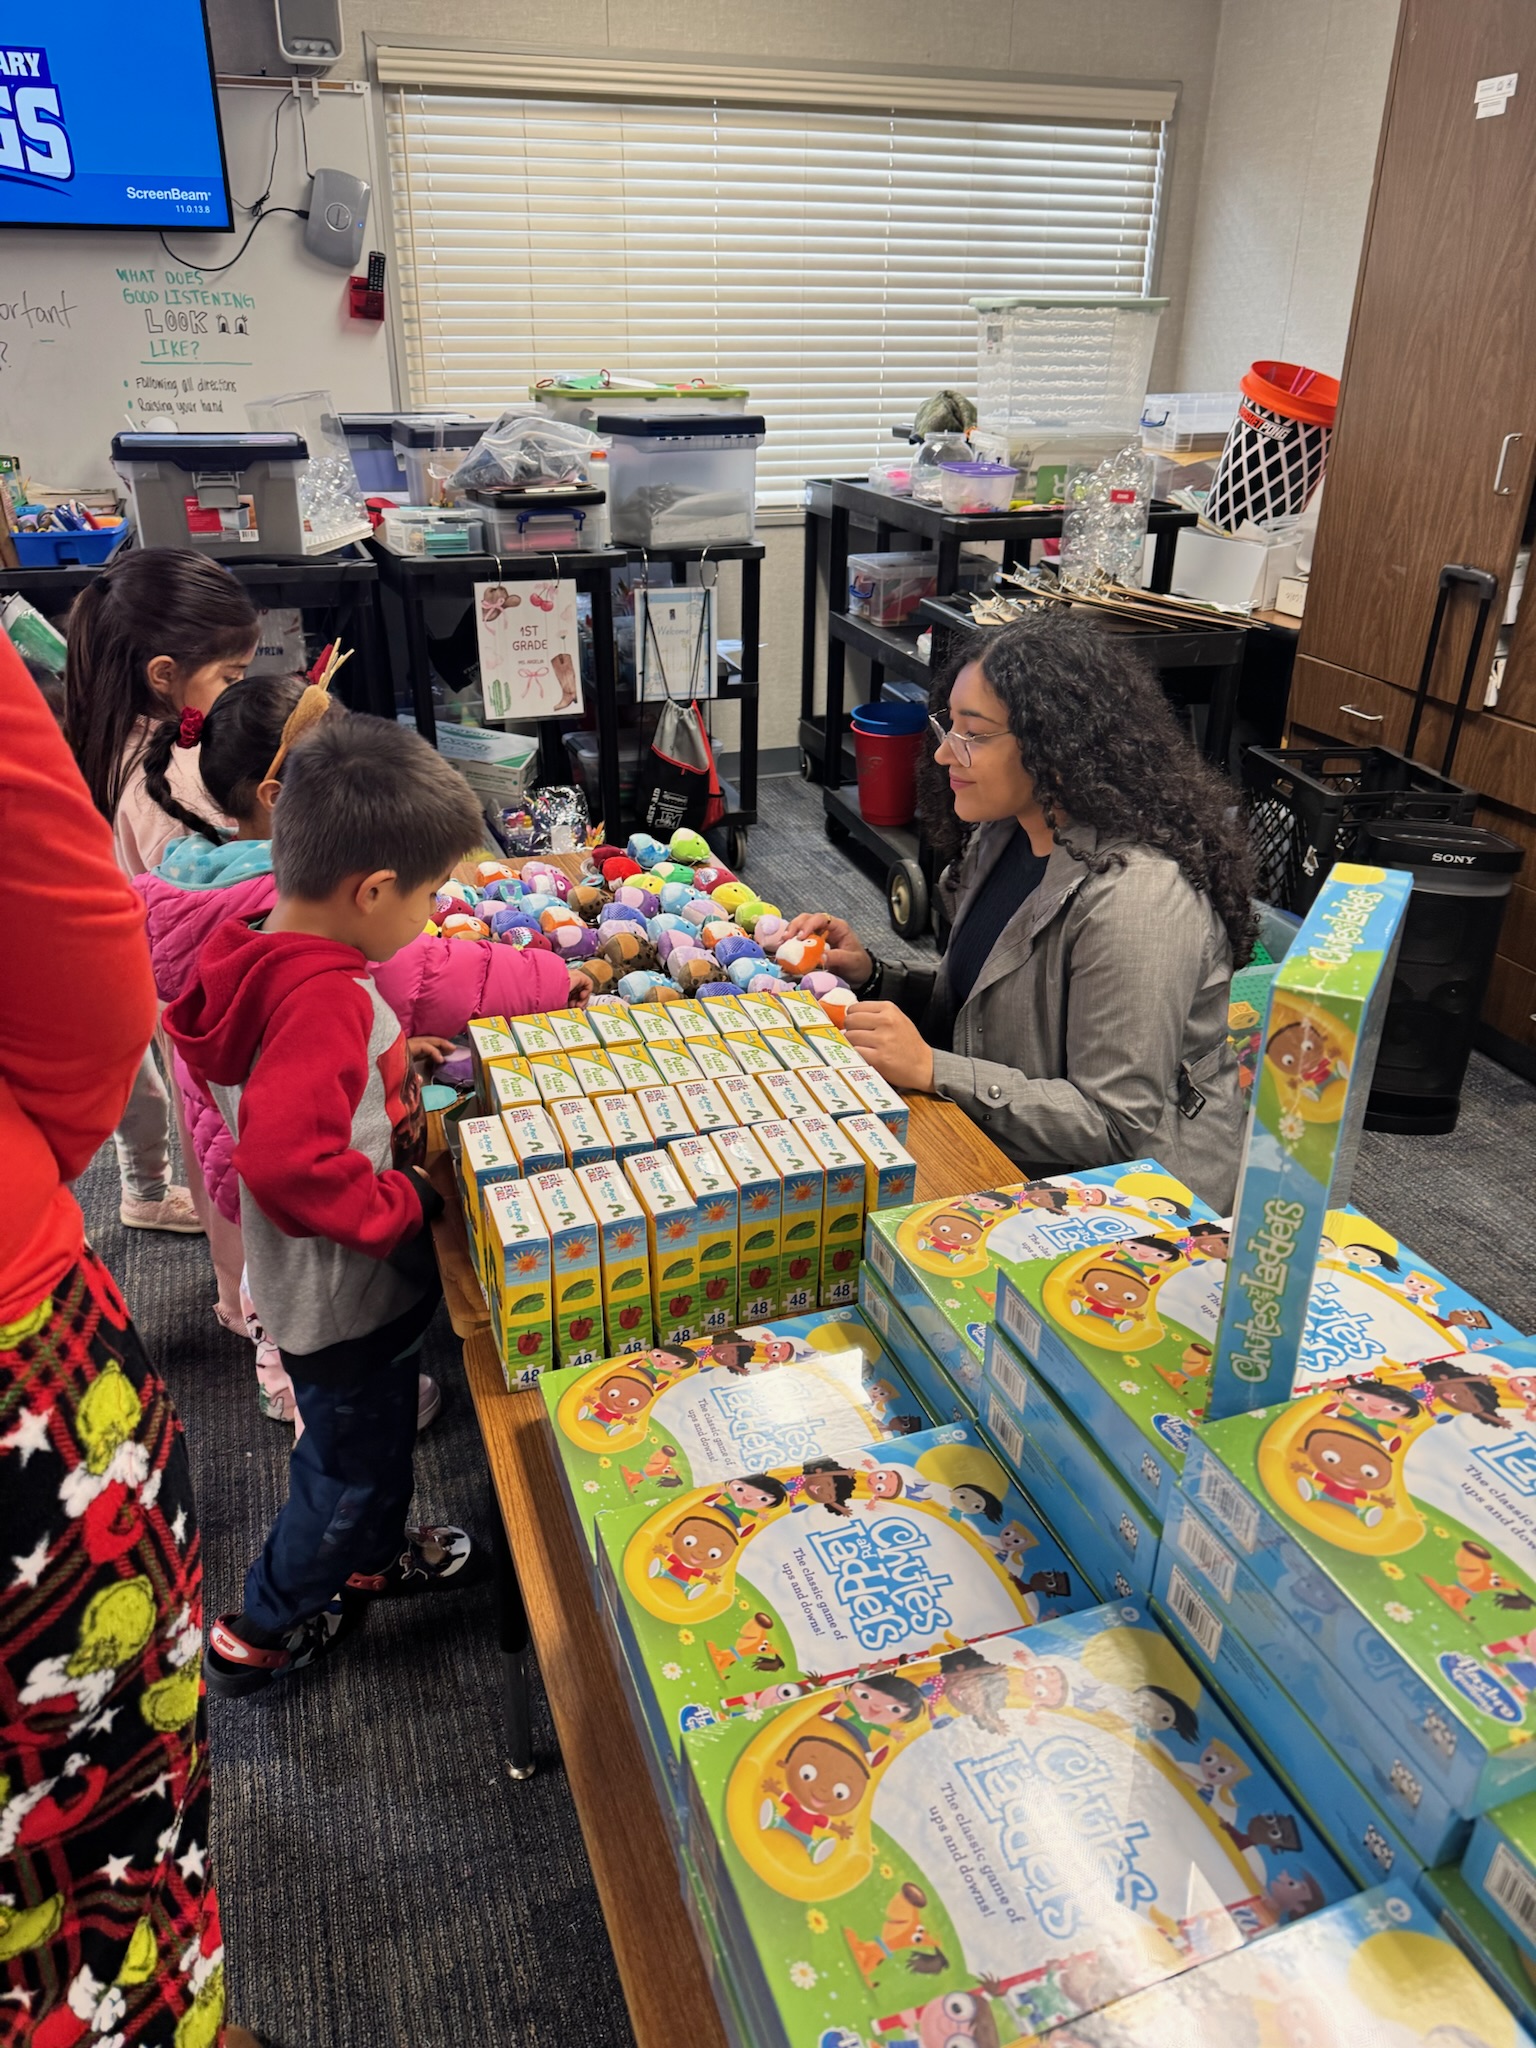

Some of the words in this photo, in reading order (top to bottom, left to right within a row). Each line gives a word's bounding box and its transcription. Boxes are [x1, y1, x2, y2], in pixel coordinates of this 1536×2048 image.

[127, 187, 208, 201] ScreenBeam
[176, 205, 210, 214] 11.0.13.8
[116, 269, 155, 283] WHAT
[165, 271, 204, 285] DOES
[123, 288, 159, 304] GOOD
[164, 290, 255, 309] LISTENING
[145, 309, 208, 334] LOOK
[150, 339, 200, 360] LIKE?
[136, 377, 179, 398] Following
[181, 377, 194, 393] all
[137, 398, 175, 415] Raising
[176, 403, 198, 415] your
[200, 399, 224, 413] hand
[520, 625, 539, 637] 1ST
[512, 640, 548, 651] GRADE
[1432, 853, 1477, 865] SONY
[686, 1014, 704, 1032] Puzzle
[725, 1010, 742, 1027] Puzzle
[760, 1007, 778, 1024] Puzzle
[799, 1006, 817, 1022] Puzzle
[568, 1025, 584, 1042] Puzzle
[610, 1020, 627, 1037] Puzzle
[651, 1018, 668, 1036] Puzzle
[488, 1034, 504, 1052] Puzzle
[531, 1031, 548, 1048] Puzzle
[709, 1052, 728, 1072] Puzzle
[750, 1049, 767, 1068] Puzzle
[789, 1045, 809, 1063] Puzzle
[831, 1045, 851, 1064] Puzzle
[630, 1063, 648, 1082] Puzzle
[670, 1056, 690, 1076] Puzzle
[551, 1072, 568, 1093] Puzzle
[591, 1068, 608, 1086] Puzzle
[509, 1077, 526, 1097] Puzzle
[1240, 1199, 1304, 1295] Ladders
[790, 1293, 807, 1306] 48
[833, 1284, 850, 1297] 48
[750, 1302, 768, 1315] 48
[708, 1312, 726, 1326] 48
[1230, 1300, 1281, 1382] Chutes
[688, 1409, 697, 1423] ups
[694, 1422, 705, 1438] and
[700, 1437, 718, 1463] downs!
[698, 1398, 708, 1413] The
[704, 1412, 719, 1438] classic
[716, 1438, 731, 1458] game
[724, 1457, 736, 1467] of
[1461, 1481, 1486, 1504] ups
[1484, 1503, 1514, 1527] and
[1464, 1464, 1489, 1487] The
[1488, 1487, 1534, 1527] classic
[856, 1538, 878, 1560] and
[807, 1520, 910, 1650] Ladders
[871, 1517, 953, 1634] Chutes
[782, 1562, 795, 1581] ups
[791, 1581, 808, 1600] and
[801, 1599, 826, 1636] downs!
[793, 1547, 807, 1566] The
[803, 1567, 822, 1600] classic
[817, 1599, 839, 1628] game
[833, 1626, 848, 1641] of
[929, 1805, 948, 1832] ups
[944, 1833, 967, 1864] and
[959, 1863, 997, 1918] downs!
[940, 1782, 959, 1813] The
[955, 1812, 986, 1863] classic
[980, 1860, 1010, 1905] game
[1006, 1904, 1026, 1924] of
